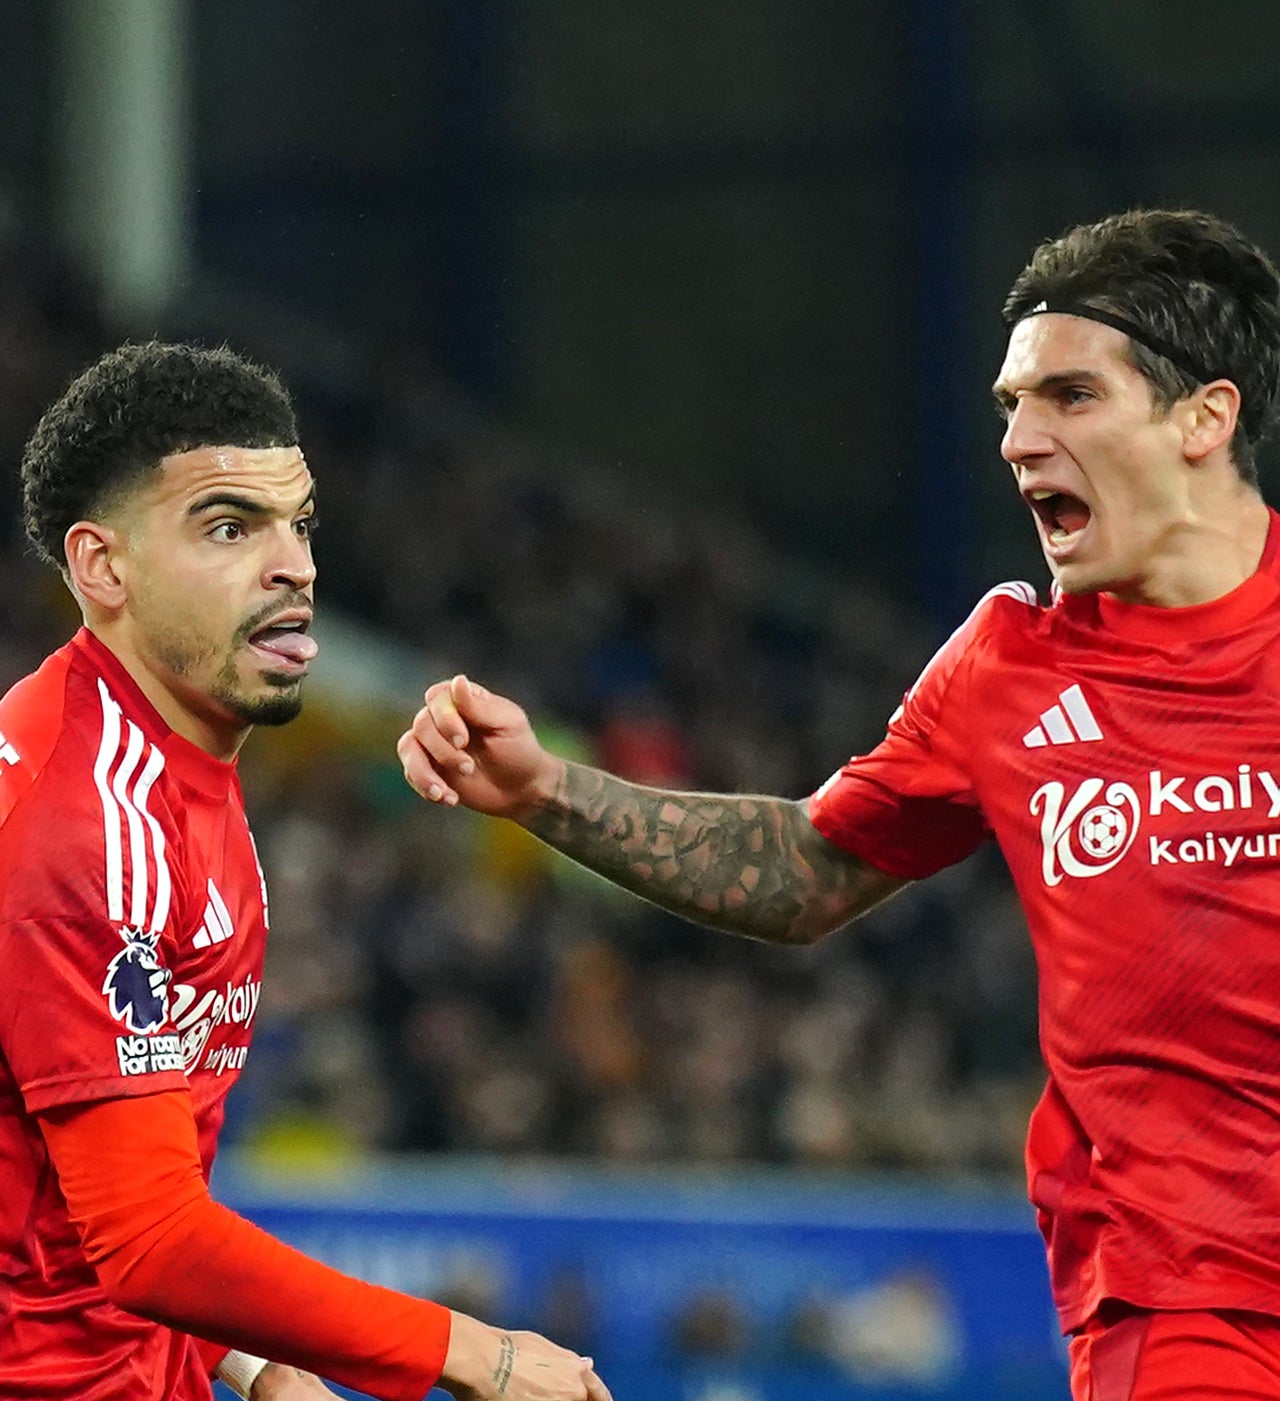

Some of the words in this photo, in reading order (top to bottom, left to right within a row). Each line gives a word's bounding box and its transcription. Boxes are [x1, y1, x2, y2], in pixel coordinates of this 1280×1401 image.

[216, 973, 262, 1029] kaiy
[115, 1036, 148, 1057] No
[118, 1054, 150, 1076] for
